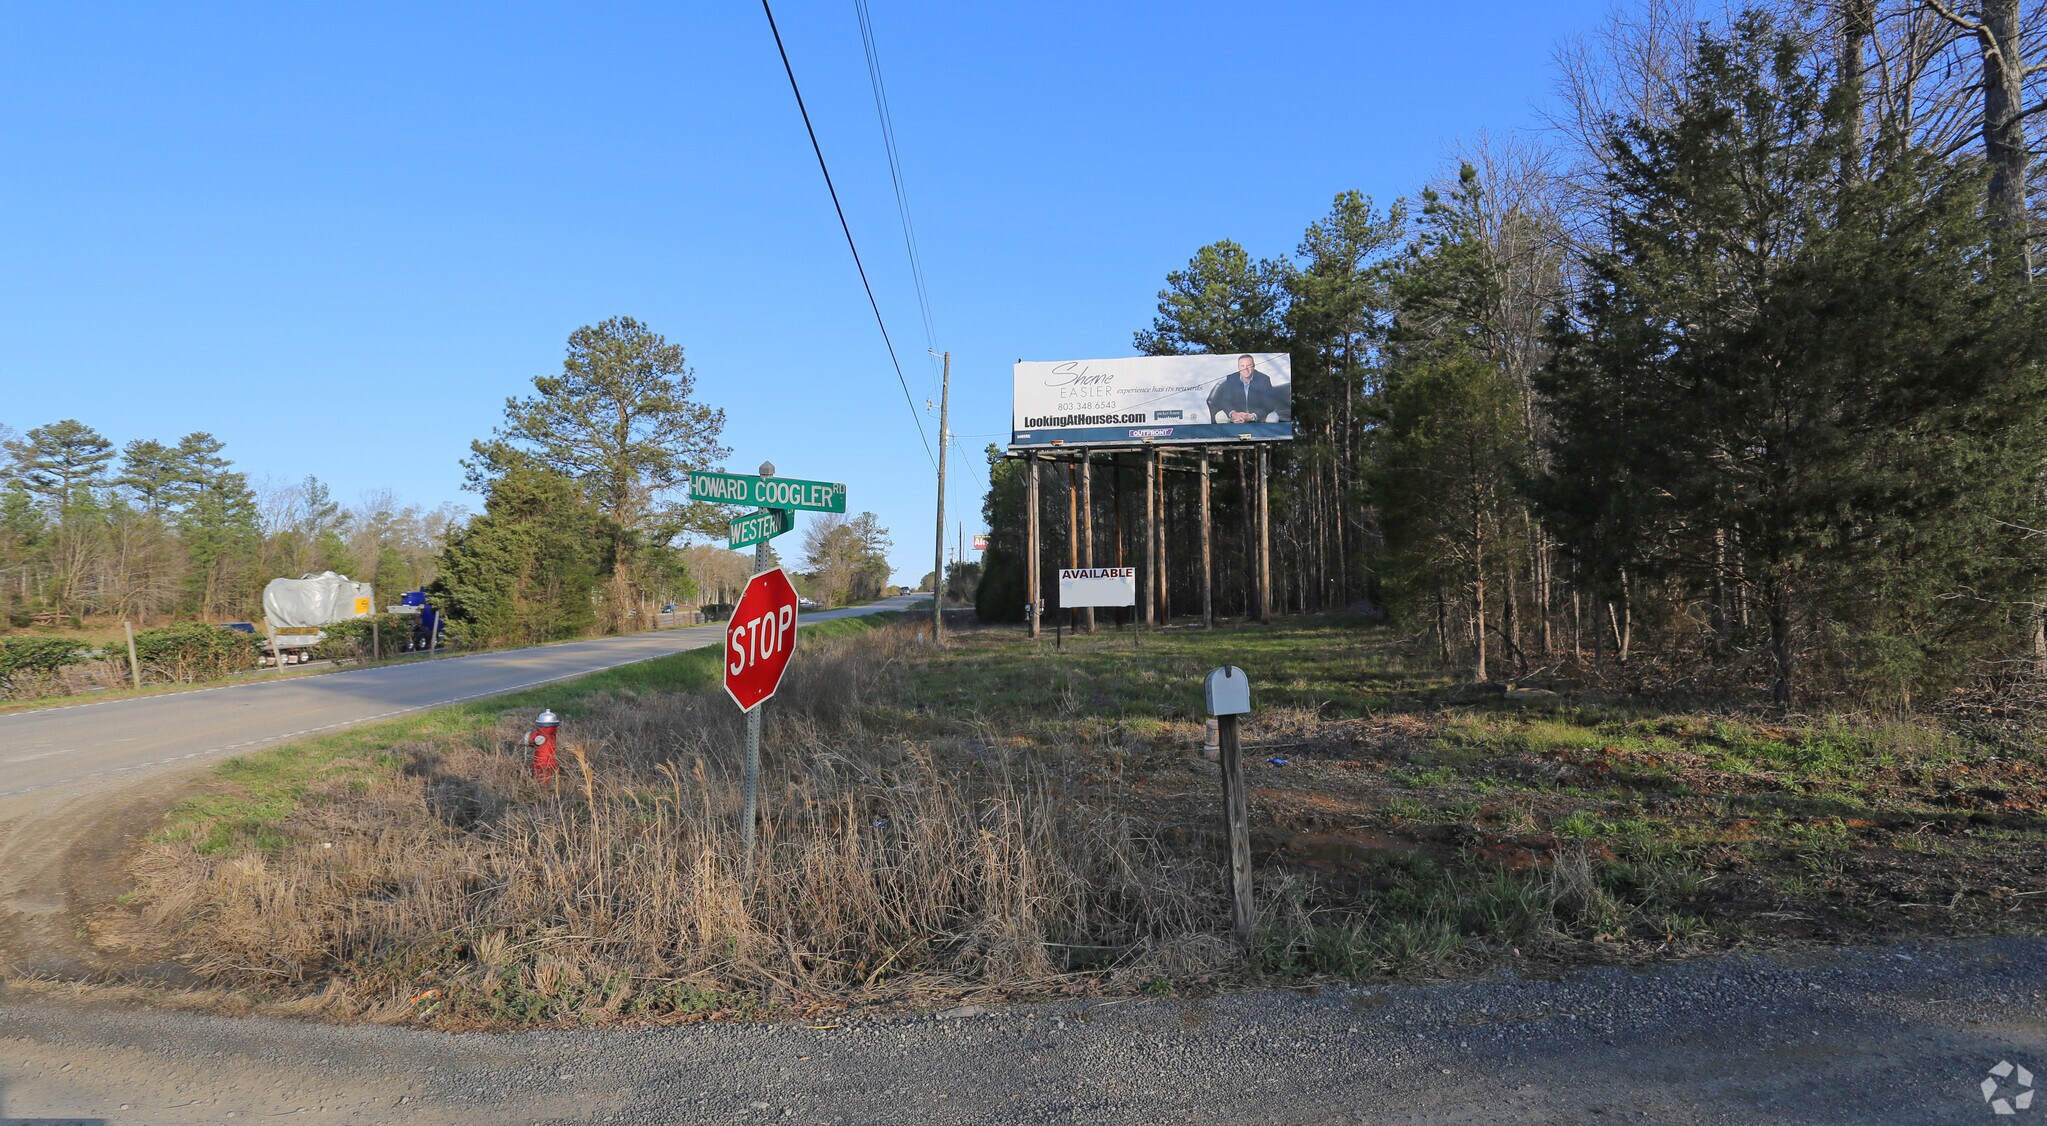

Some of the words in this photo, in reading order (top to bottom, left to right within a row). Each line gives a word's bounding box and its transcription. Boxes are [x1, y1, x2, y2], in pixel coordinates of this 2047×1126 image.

[1044, 361, 1114, 387] Shane
[1060, 386, 1112, 399] EASLER
[1116, 386, 1151, 395] experience
[1151, 385, 1164, 393] has
[1165, 385, 1174, 393] its
[1175, 384, 1204, 393] rewards
[1057, 401, 1116, 411] 803.348.6543
[1024, 413, 1146, 428] LookingAtHouses.com
[1133, 429, 1168, 437] OUTFRONT
[689, 475, 748, 500] HOWARD
[755, 481, 833, 507] COOGLER
[832, 483, 846, 495] RD
[730, 511, 782, 545] WESTERN
[1062, 568, 1133, 580] AVAILABLE
[730, 604, 793, 676] STOP
